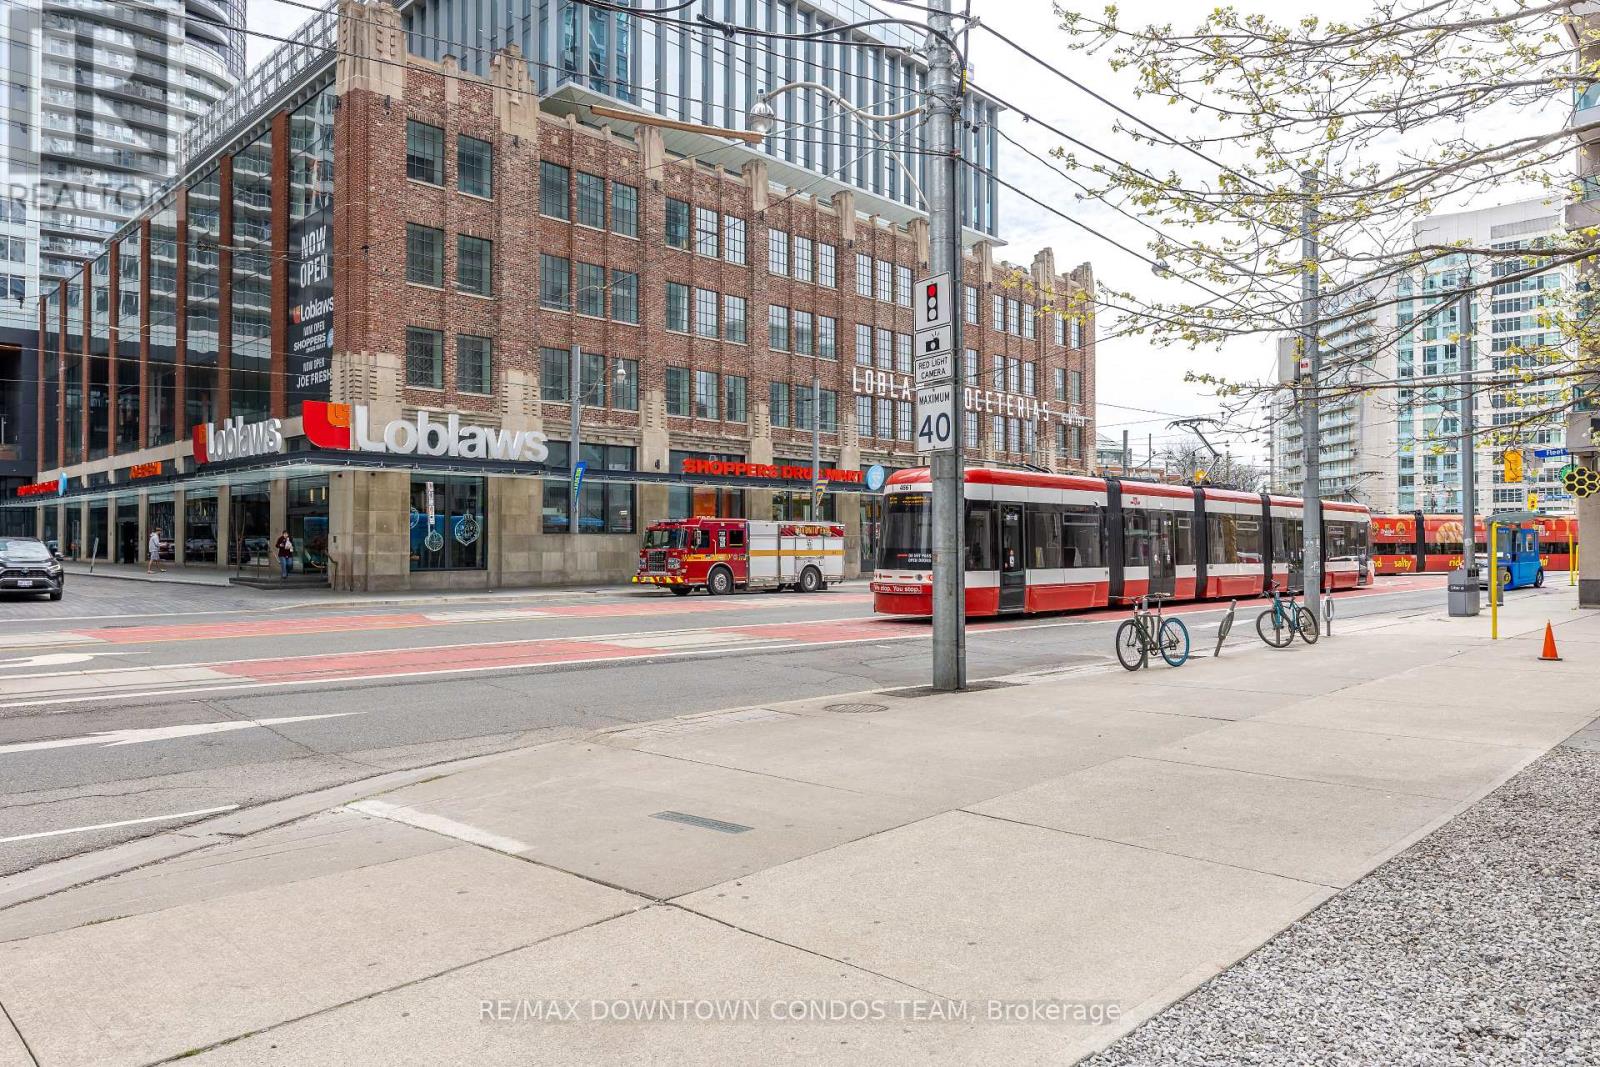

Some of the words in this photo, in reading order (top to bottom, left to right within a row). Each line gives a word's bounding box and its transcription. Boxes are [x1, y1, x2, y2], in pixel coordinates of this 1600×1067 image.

[301, 225, 327, 260] NOW
[300, 253, 328, 289] OPEN
[300, 296, 334, 322] Loblaws
[293, 333, 327, 352] SHOPPERS
[918, 359, 930, 370] RED
[931, 356, 949, 368] LIGHT
[920, 368, 946, 380] CAMERA
[296, 374, 310, 389] JOE
[310, 368, 333, 386] FRESH
[853, 367, 912, 401] LOBLA
[964, 387, 1050, 422] OCETERIAS
[918, 391, 950, 406] MAXIMUM
[206, 415, 283, 463] Loblaws
[355, 405, 549, 463] Loblaws
[918, 412, 951, 444] 40
[682, 458, 779, 479] SHOPPERS
[825, 469, 864, 483] MART
[1394, 556, 1412, 571] salty
